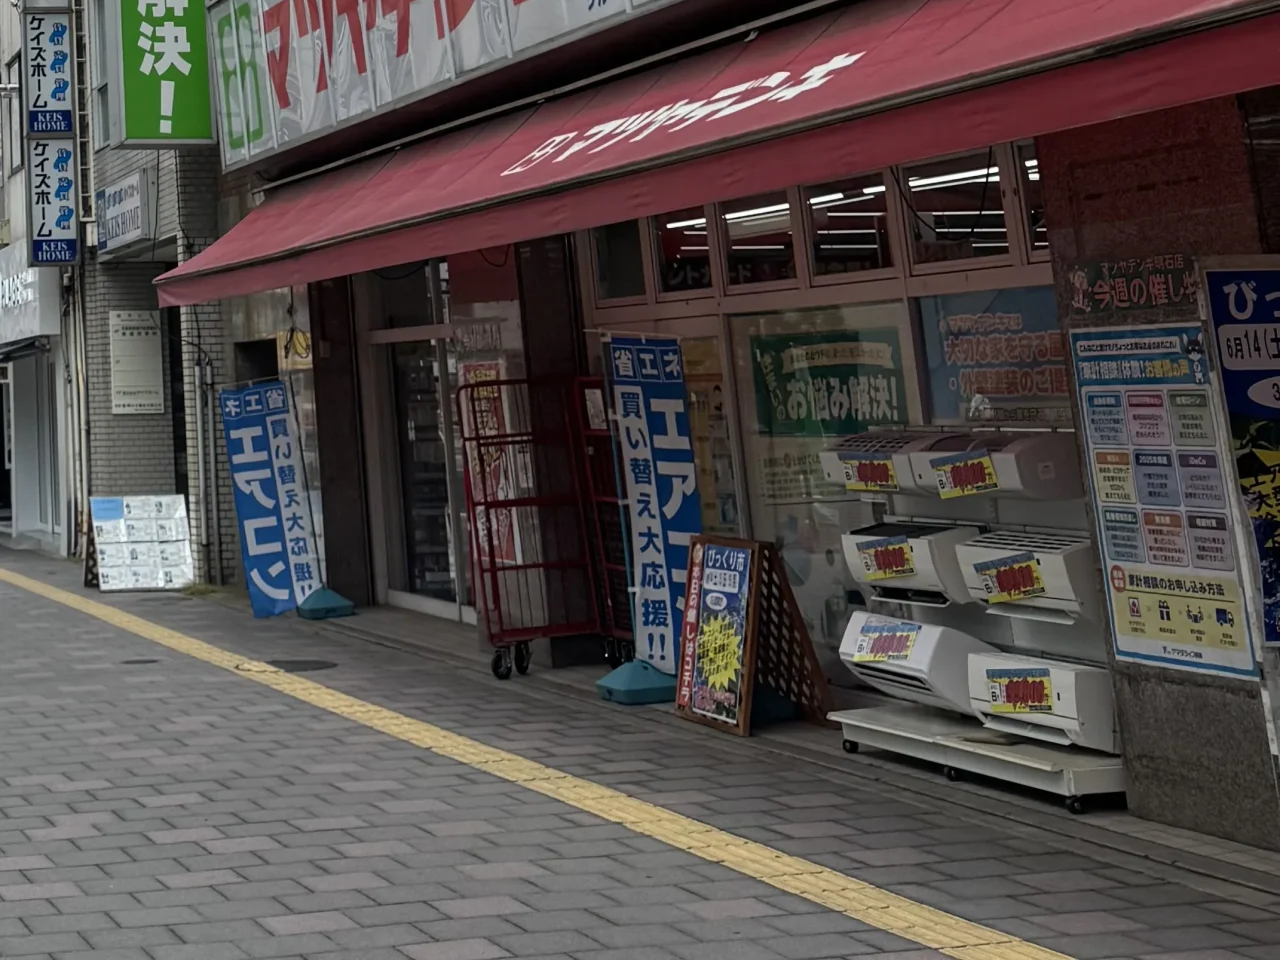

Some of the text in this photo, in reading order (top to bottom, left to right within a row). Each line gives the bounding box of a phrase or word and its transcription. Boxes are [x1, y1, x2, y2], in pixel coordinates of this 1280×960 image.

[29, 16, 48, 108] ケイズホーム
[38, 112, 63, 122] KEIS
[552, 51, 867, 163] マツヤデンキ
[33, 121, 69, 131] HOME
[33, 141, 52, 238] ケイズホーム
[120, 206, 141, 235] HOME
[38, 251, 72, 261] HOME
[42, 242, 67, 251] KEIS
[1100, 254, 1184, 275] マツヤデンキ明石店
[614, 348, 682, 379] 省エネ
[787, 374, 898, 421] お悩み解決!
[650, 398, 696, 611] エアコ
[620, 392, 669, 661] 買い替え大応援!!
[708, 549, 746, 572] びっくり市
[1129, 574, 1226, 596] 家計相談のお申し込み方法
